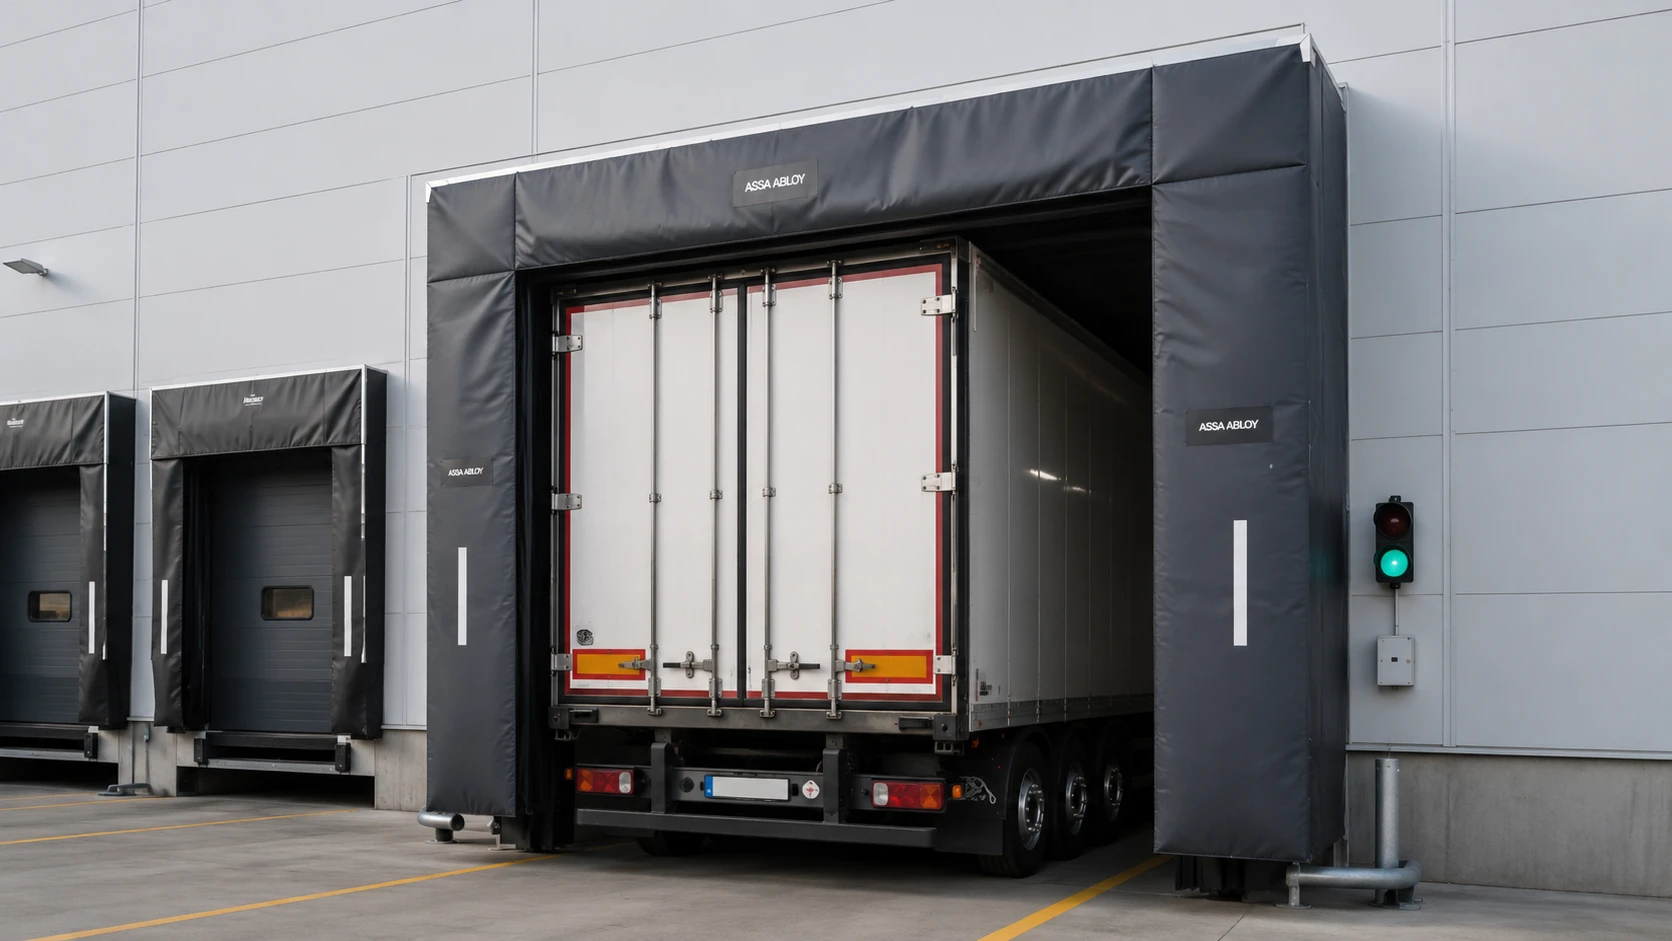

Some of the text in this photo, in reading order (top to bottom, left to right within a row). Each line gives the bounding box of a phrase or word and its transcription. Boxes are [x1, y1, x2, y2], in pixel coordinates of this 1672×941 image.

[744, 173, 806, 192] ASSA ABLOY
[1198, 419, 1259, 431] ASSA ABLOY
